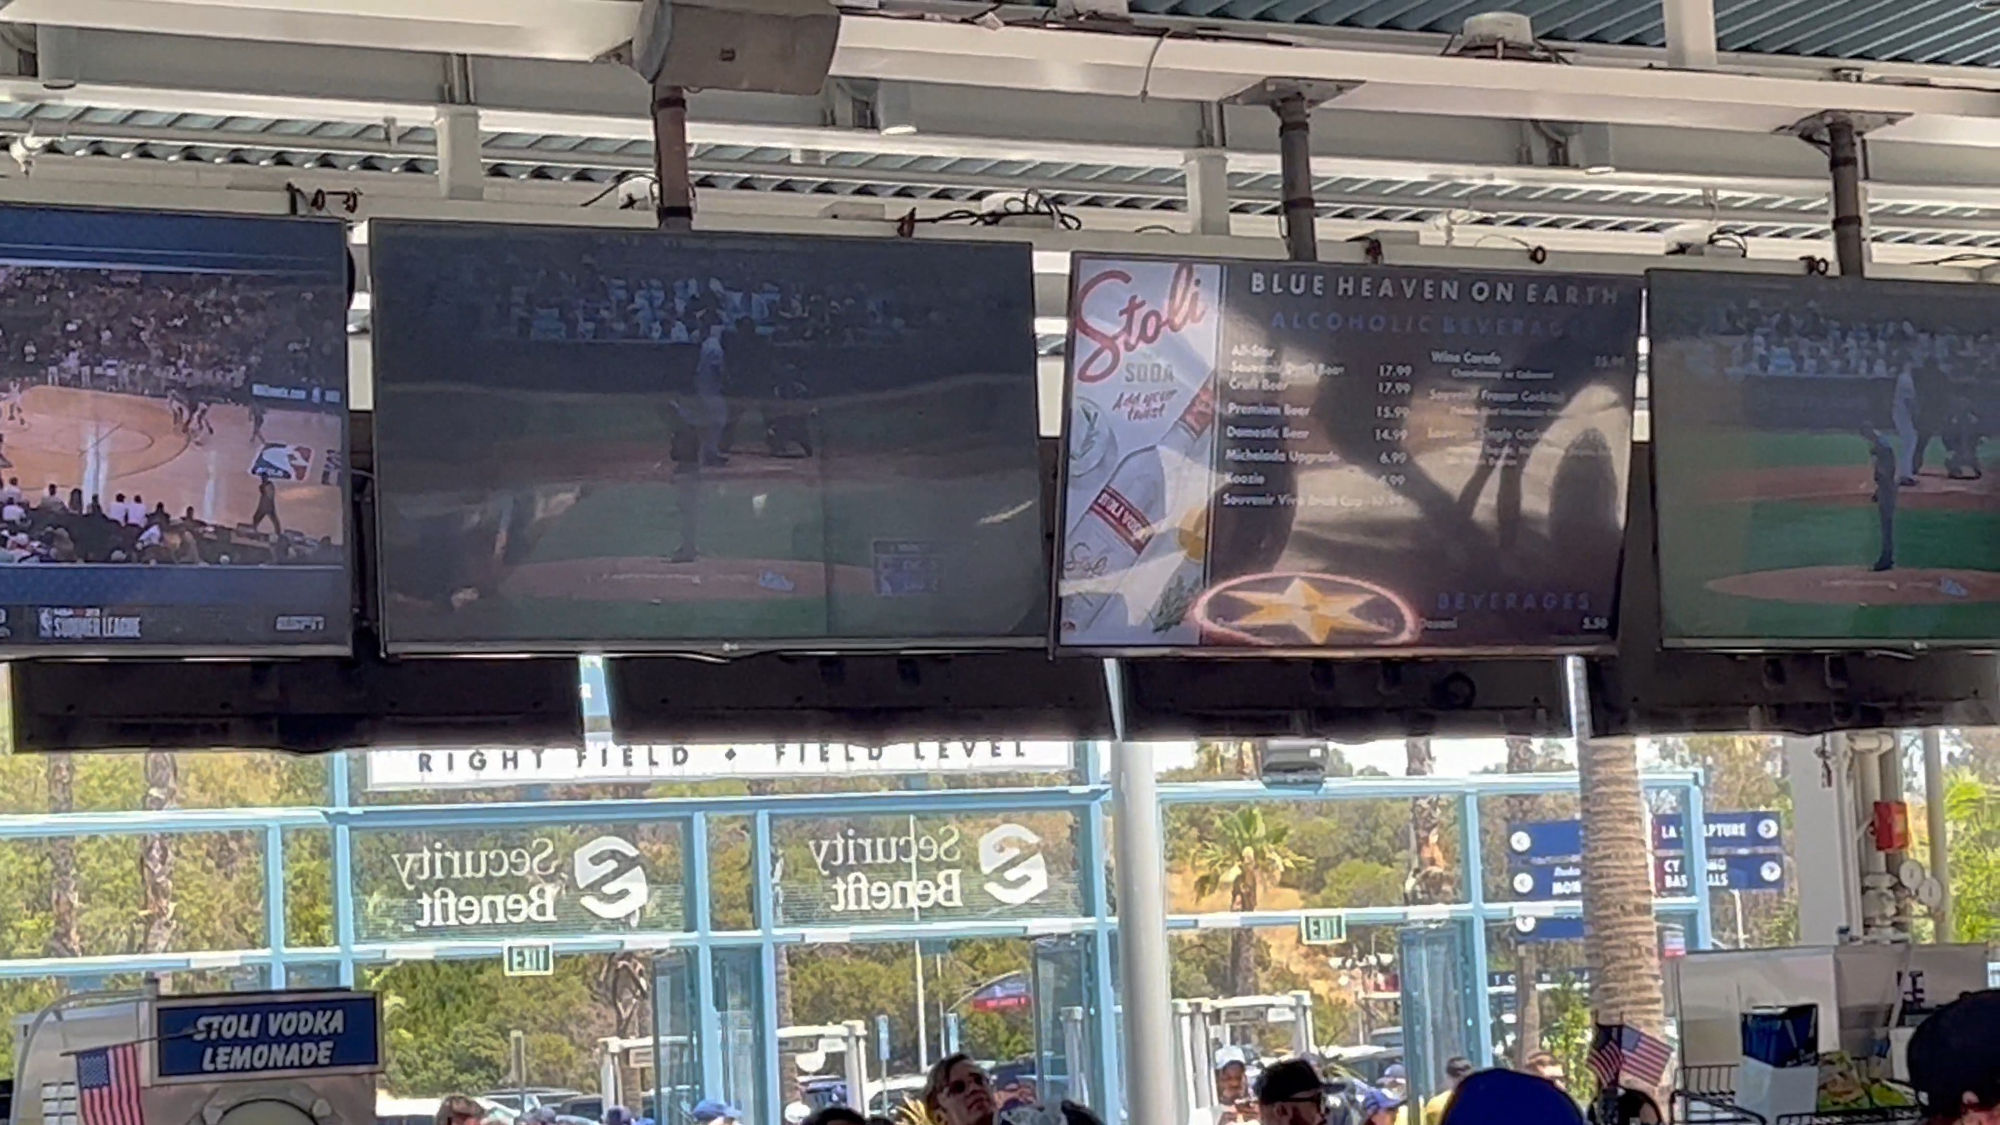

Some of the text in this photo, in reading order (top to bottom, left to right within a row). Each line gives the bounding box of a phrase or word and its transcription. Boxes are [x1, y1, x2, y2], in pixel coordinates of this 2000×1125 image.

[1251, 272, 1618, 305] BLUE HEAVEN ON EARTH
[1074, 263, 1206, 383] Stoli
[1271, 311, 1600, 340] ALCOHOLIC BEVERAG
[1125, 362, 1175, 382] SODA
[1262, 378, 1289, 391] Beer
[1227, 402, 1281, 416] Premium
[1284, 404, 1310, 417] Beer
[1226, 426, 1408, 442] Domestic Beer 14.99
[1225, 449, 1407, 466] Michelada Upgrade 6.99
[1224, 470, 1266, 486] Koozie
[1223, 492, 1275, 506] Souvenir
[1437, 592, 1592, 611] BEVERAGES
[418, 739, 1026, 773] RIGHT FIELD FIELD LEVEL
[1661, 824, 1678, 840] LA
[1308, 916, 1342, 942] EXIT
[511, 945, 549, 972] EXIT
[193, 1009, 345, 1041] STOLI VODKA
[202, 1040, 334, 1072] LEMONADE
